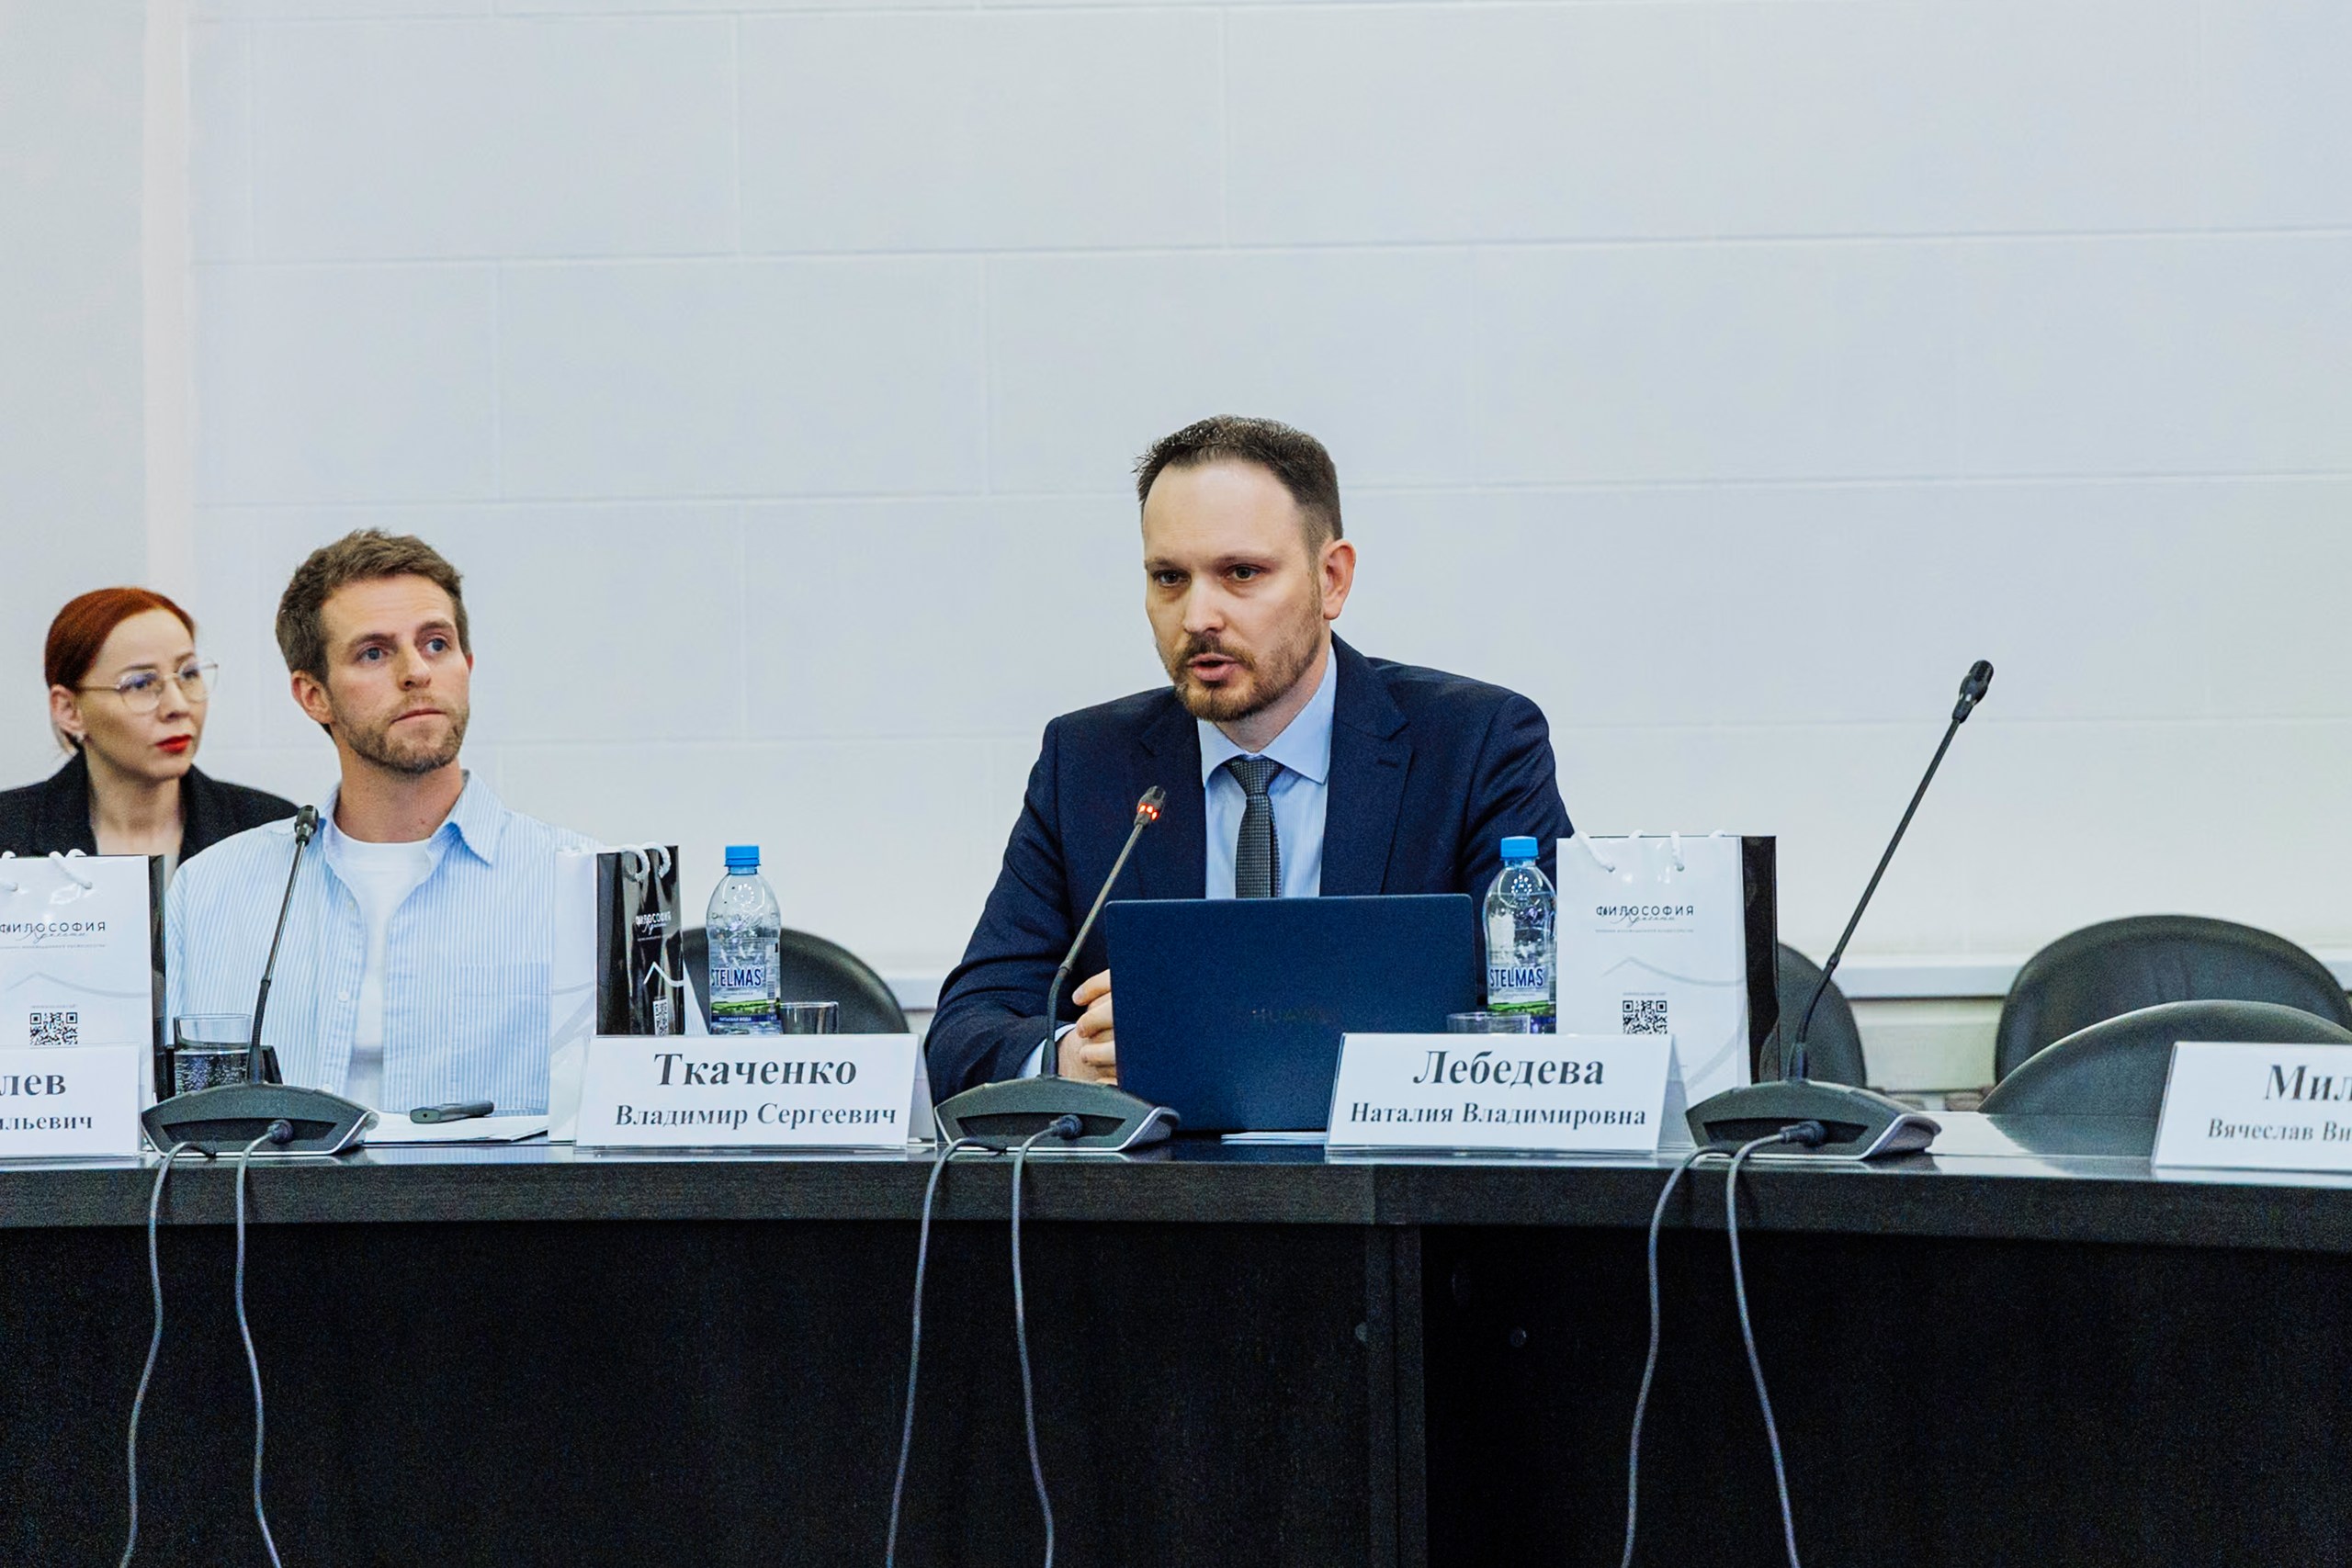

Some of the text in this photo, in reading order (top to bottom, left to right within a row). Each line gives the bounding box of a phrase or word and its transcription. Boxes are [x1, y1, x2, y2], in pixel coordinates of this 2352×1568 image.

[1596, 905, 1694, 917] ФИЛОСОФИЯ
[711, 968, 762, 987] STELMAS
[1489, 967, 1544, 987] STELMAS
[653, 1054, 857, 1086] Ткаченко
[1413, 1050, 1604, 1089] Лебедева
[616, 1102, 897, 1131] Владимир Сергеевич
[1351, 1102, 1645, 1131] Наталия Владимировна
[2208, 1118, 2313, 1141] Вячеслав
